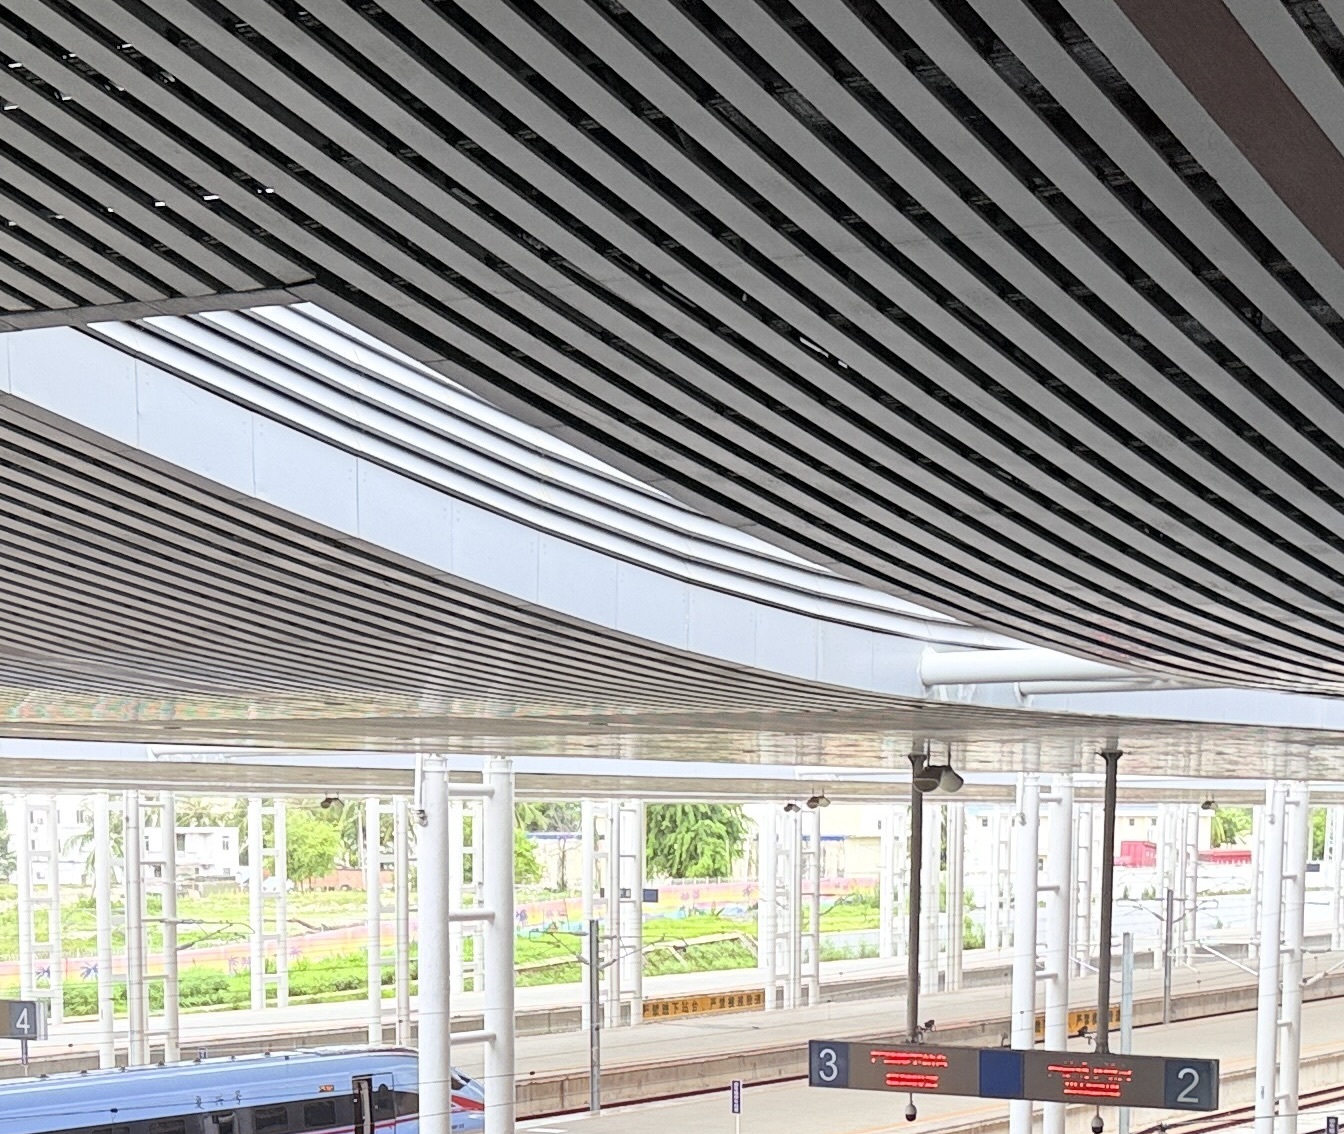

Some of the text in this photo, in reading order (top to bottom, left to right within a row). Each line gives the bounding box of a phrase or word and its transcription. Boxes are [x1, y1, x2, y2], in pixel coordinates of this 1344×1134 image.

[15, 1007, 31, 1035] 4
[819, 1048, 838, 1081] 3
[1176, 1067, 1200, 1103] 2
